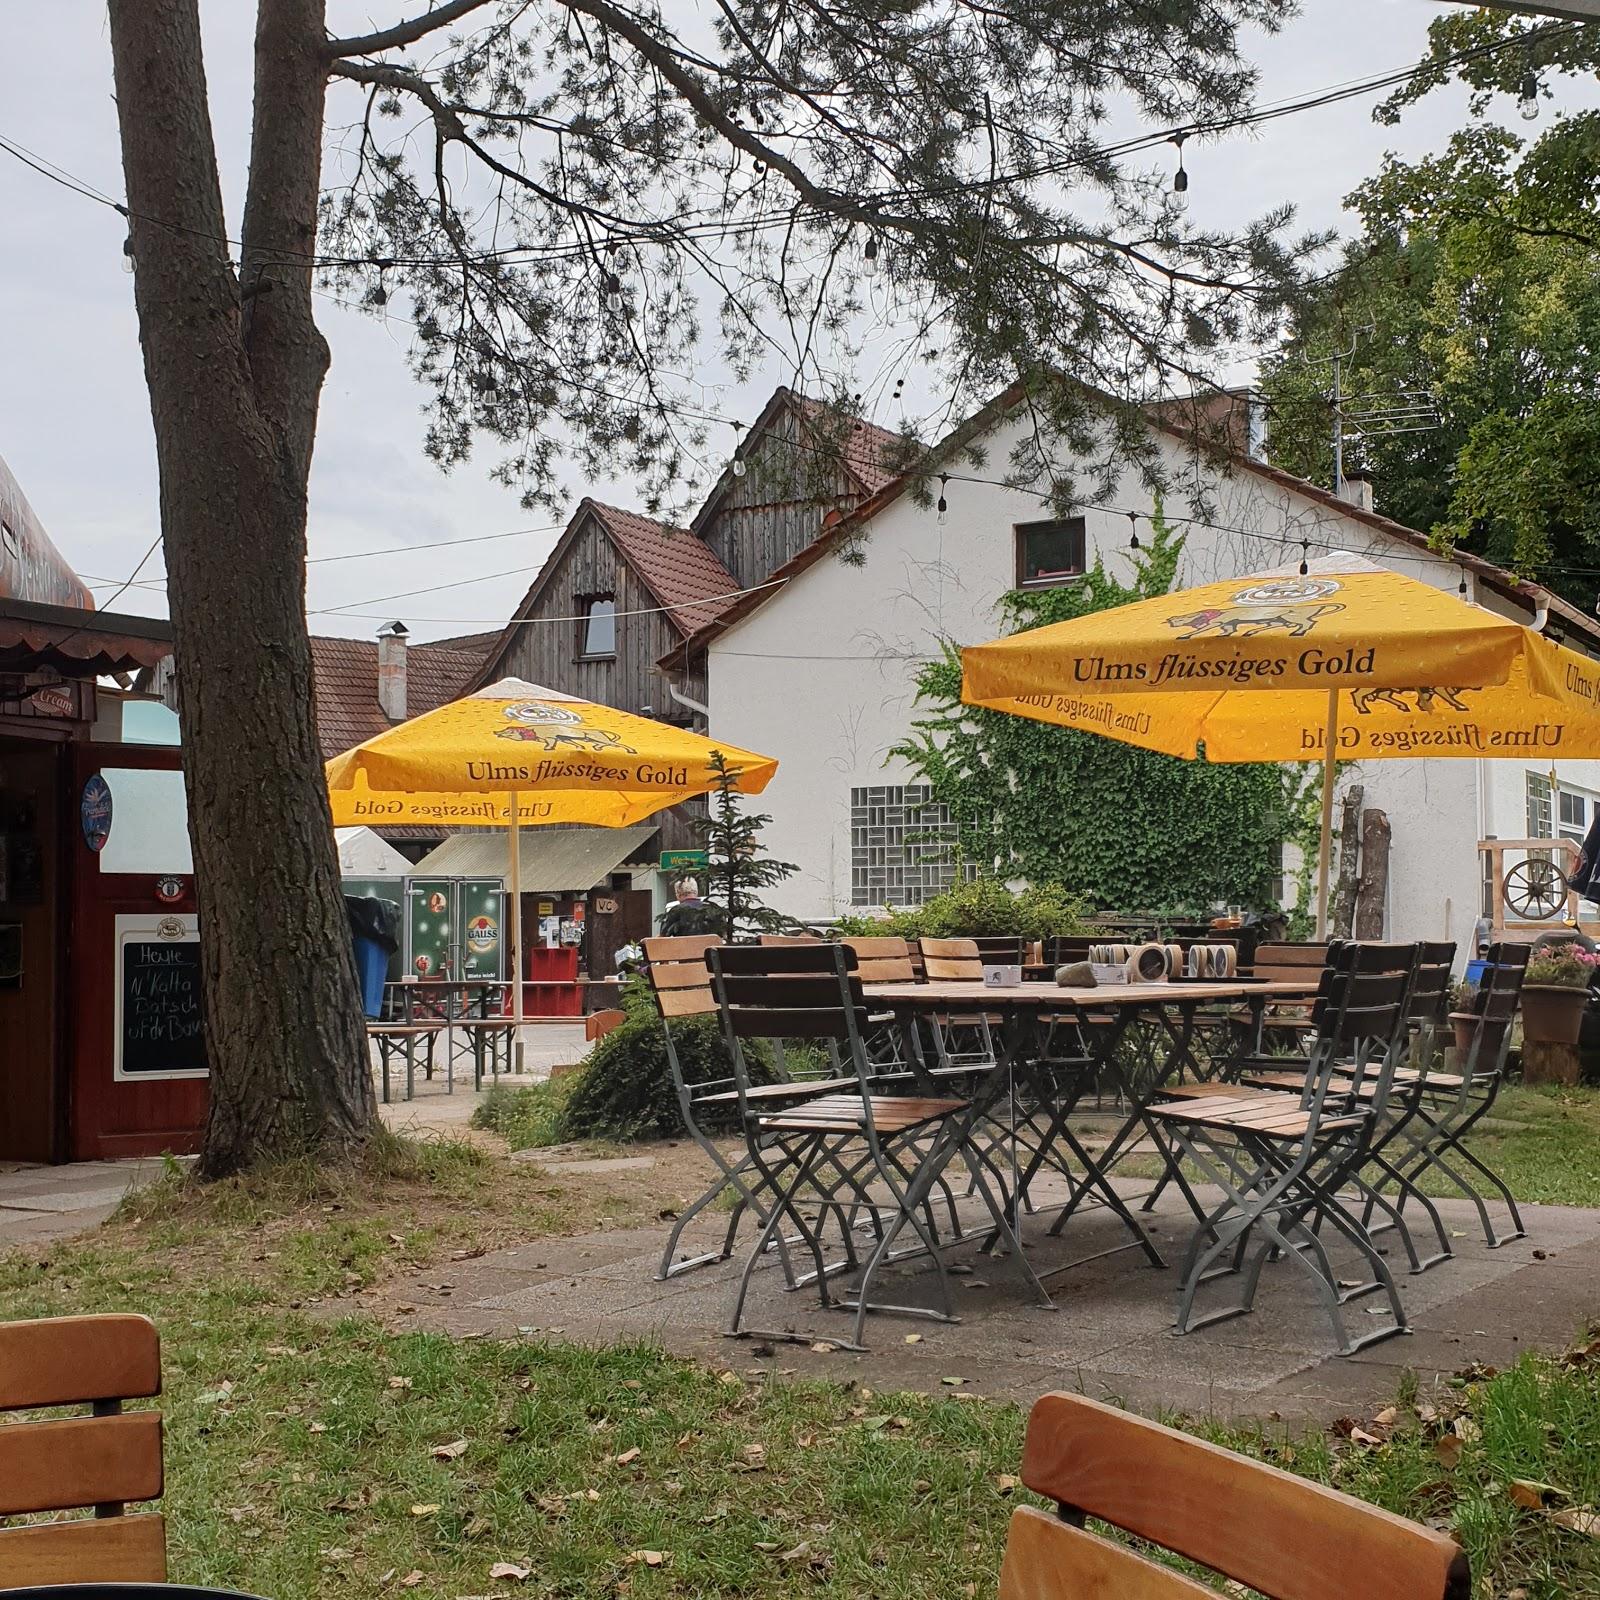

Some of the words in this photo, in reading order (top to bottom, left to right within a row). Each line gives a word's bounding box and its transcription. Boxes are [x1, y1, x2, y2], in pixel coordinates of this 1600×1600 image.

[1073, 657, 1147, 682] Ulms
[1145, 651, 1288, 686] flüssiges
[1298, 647, 1376, 675] Gold
[1566, 663, 1592, 699] Ulms
[40, 689, 74, 712] Cream
[467, 761, 529, 781] Ulms
[531, 759, 630, 783] flüssiges
[636, 764, 688, 786] Gold
[467, 929, 498, 940] GAUSS
